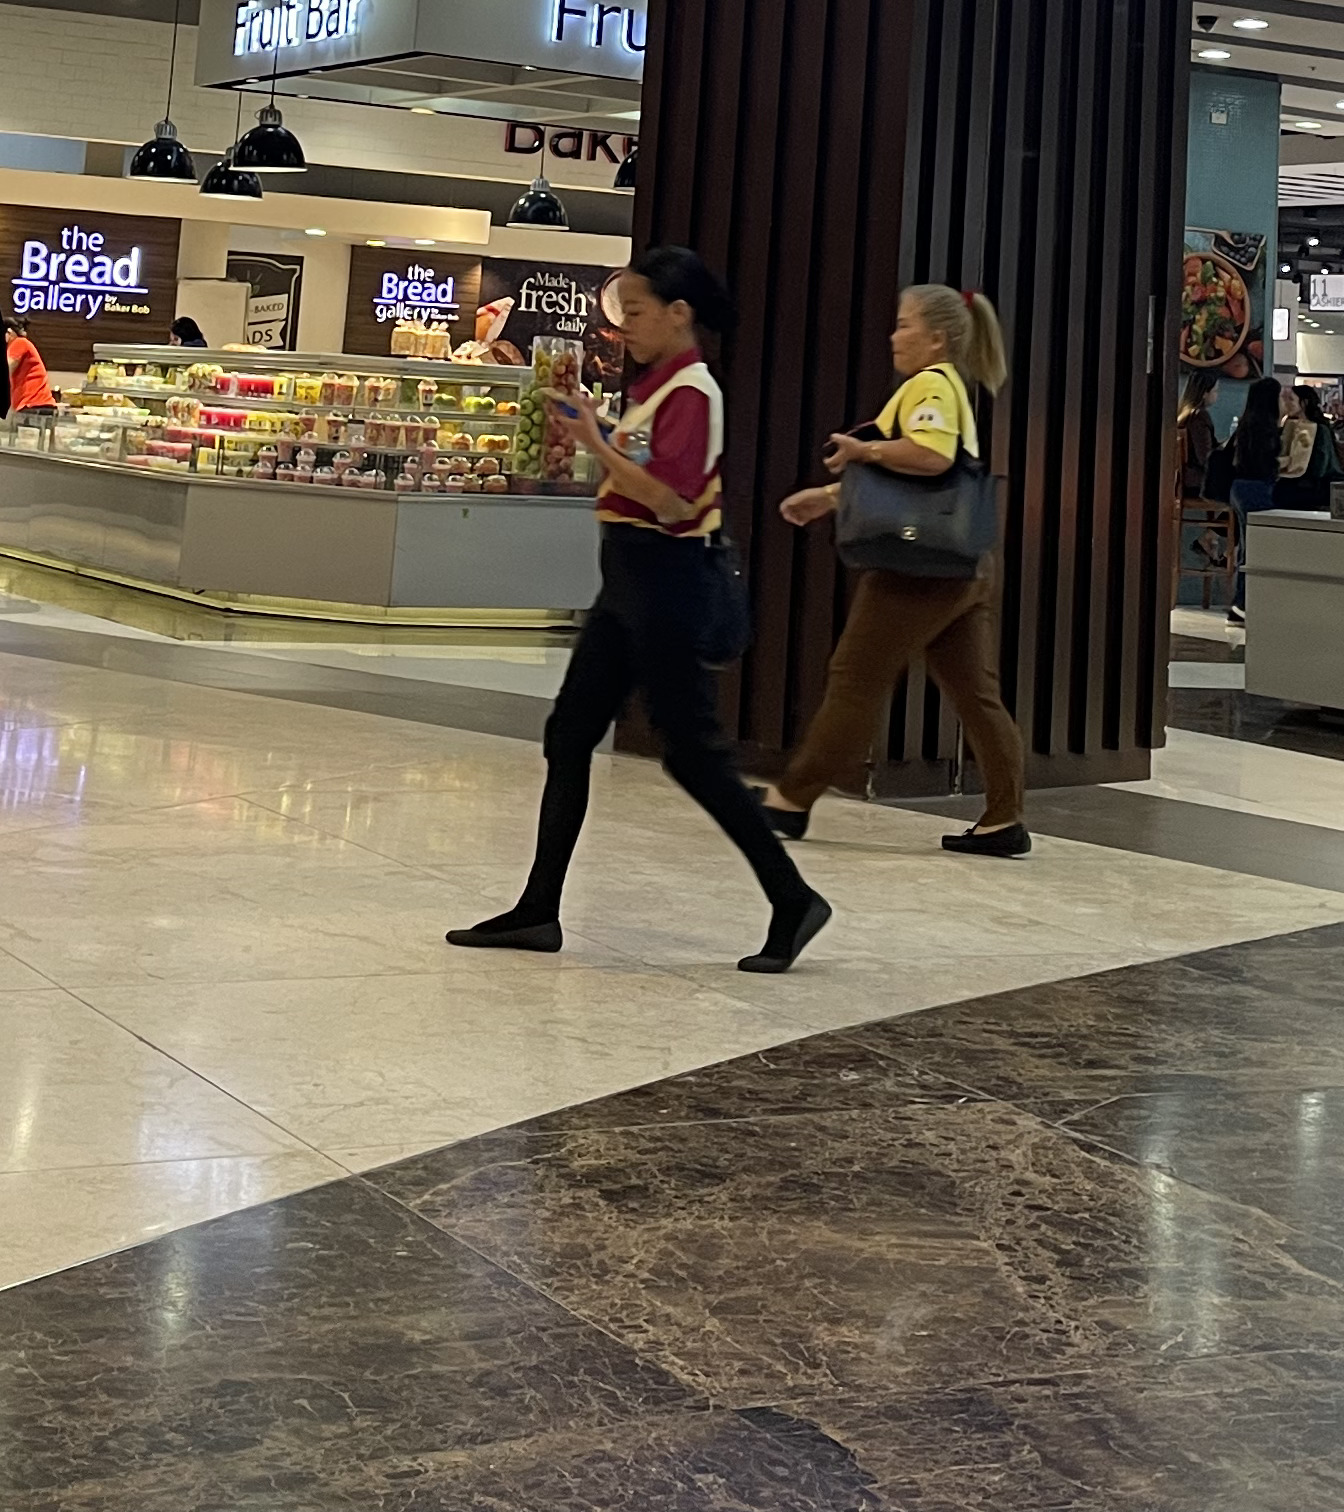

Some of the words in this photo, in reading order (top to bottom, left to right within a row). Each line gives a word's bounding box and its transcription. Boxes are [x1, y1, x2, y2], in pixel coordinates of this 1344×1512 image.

[61, 225, 104, 252] the
[21, 240, 140, 287] Bread
[407, 264, 435, 281] the
[381, 272, 455, 303] Bread
[536, 272, 570, 288] Made
[1311, 278, 1328, 297] 11
[12, 284, 104, 320] gallery
[105, 294, 117, 304] by
[517, 277, 588, 316] fresh
[375, 301, 431, 324] gallery
[556, 316, 587, 336] daily
